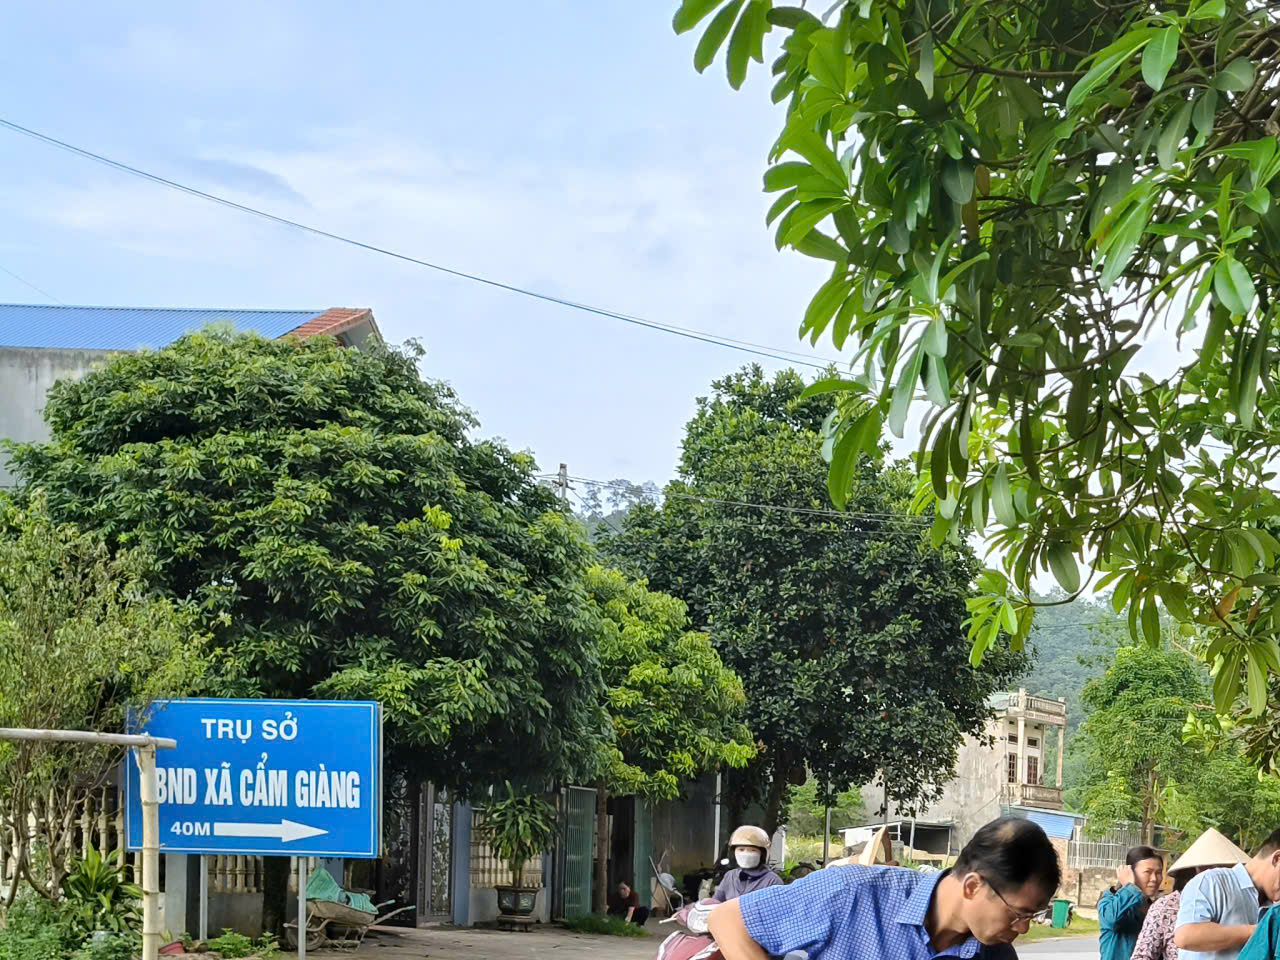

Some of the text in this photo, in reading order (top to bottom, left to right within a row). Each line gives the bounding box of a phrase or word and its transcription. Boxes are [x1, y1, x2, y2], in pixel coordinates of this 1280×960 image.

[201, 711, 298, 743] TRỤ SỞ
[140, 752, 361, 808] BND XÃ CẨM GIÀNG
[170, 821, 211, 836] 40M
